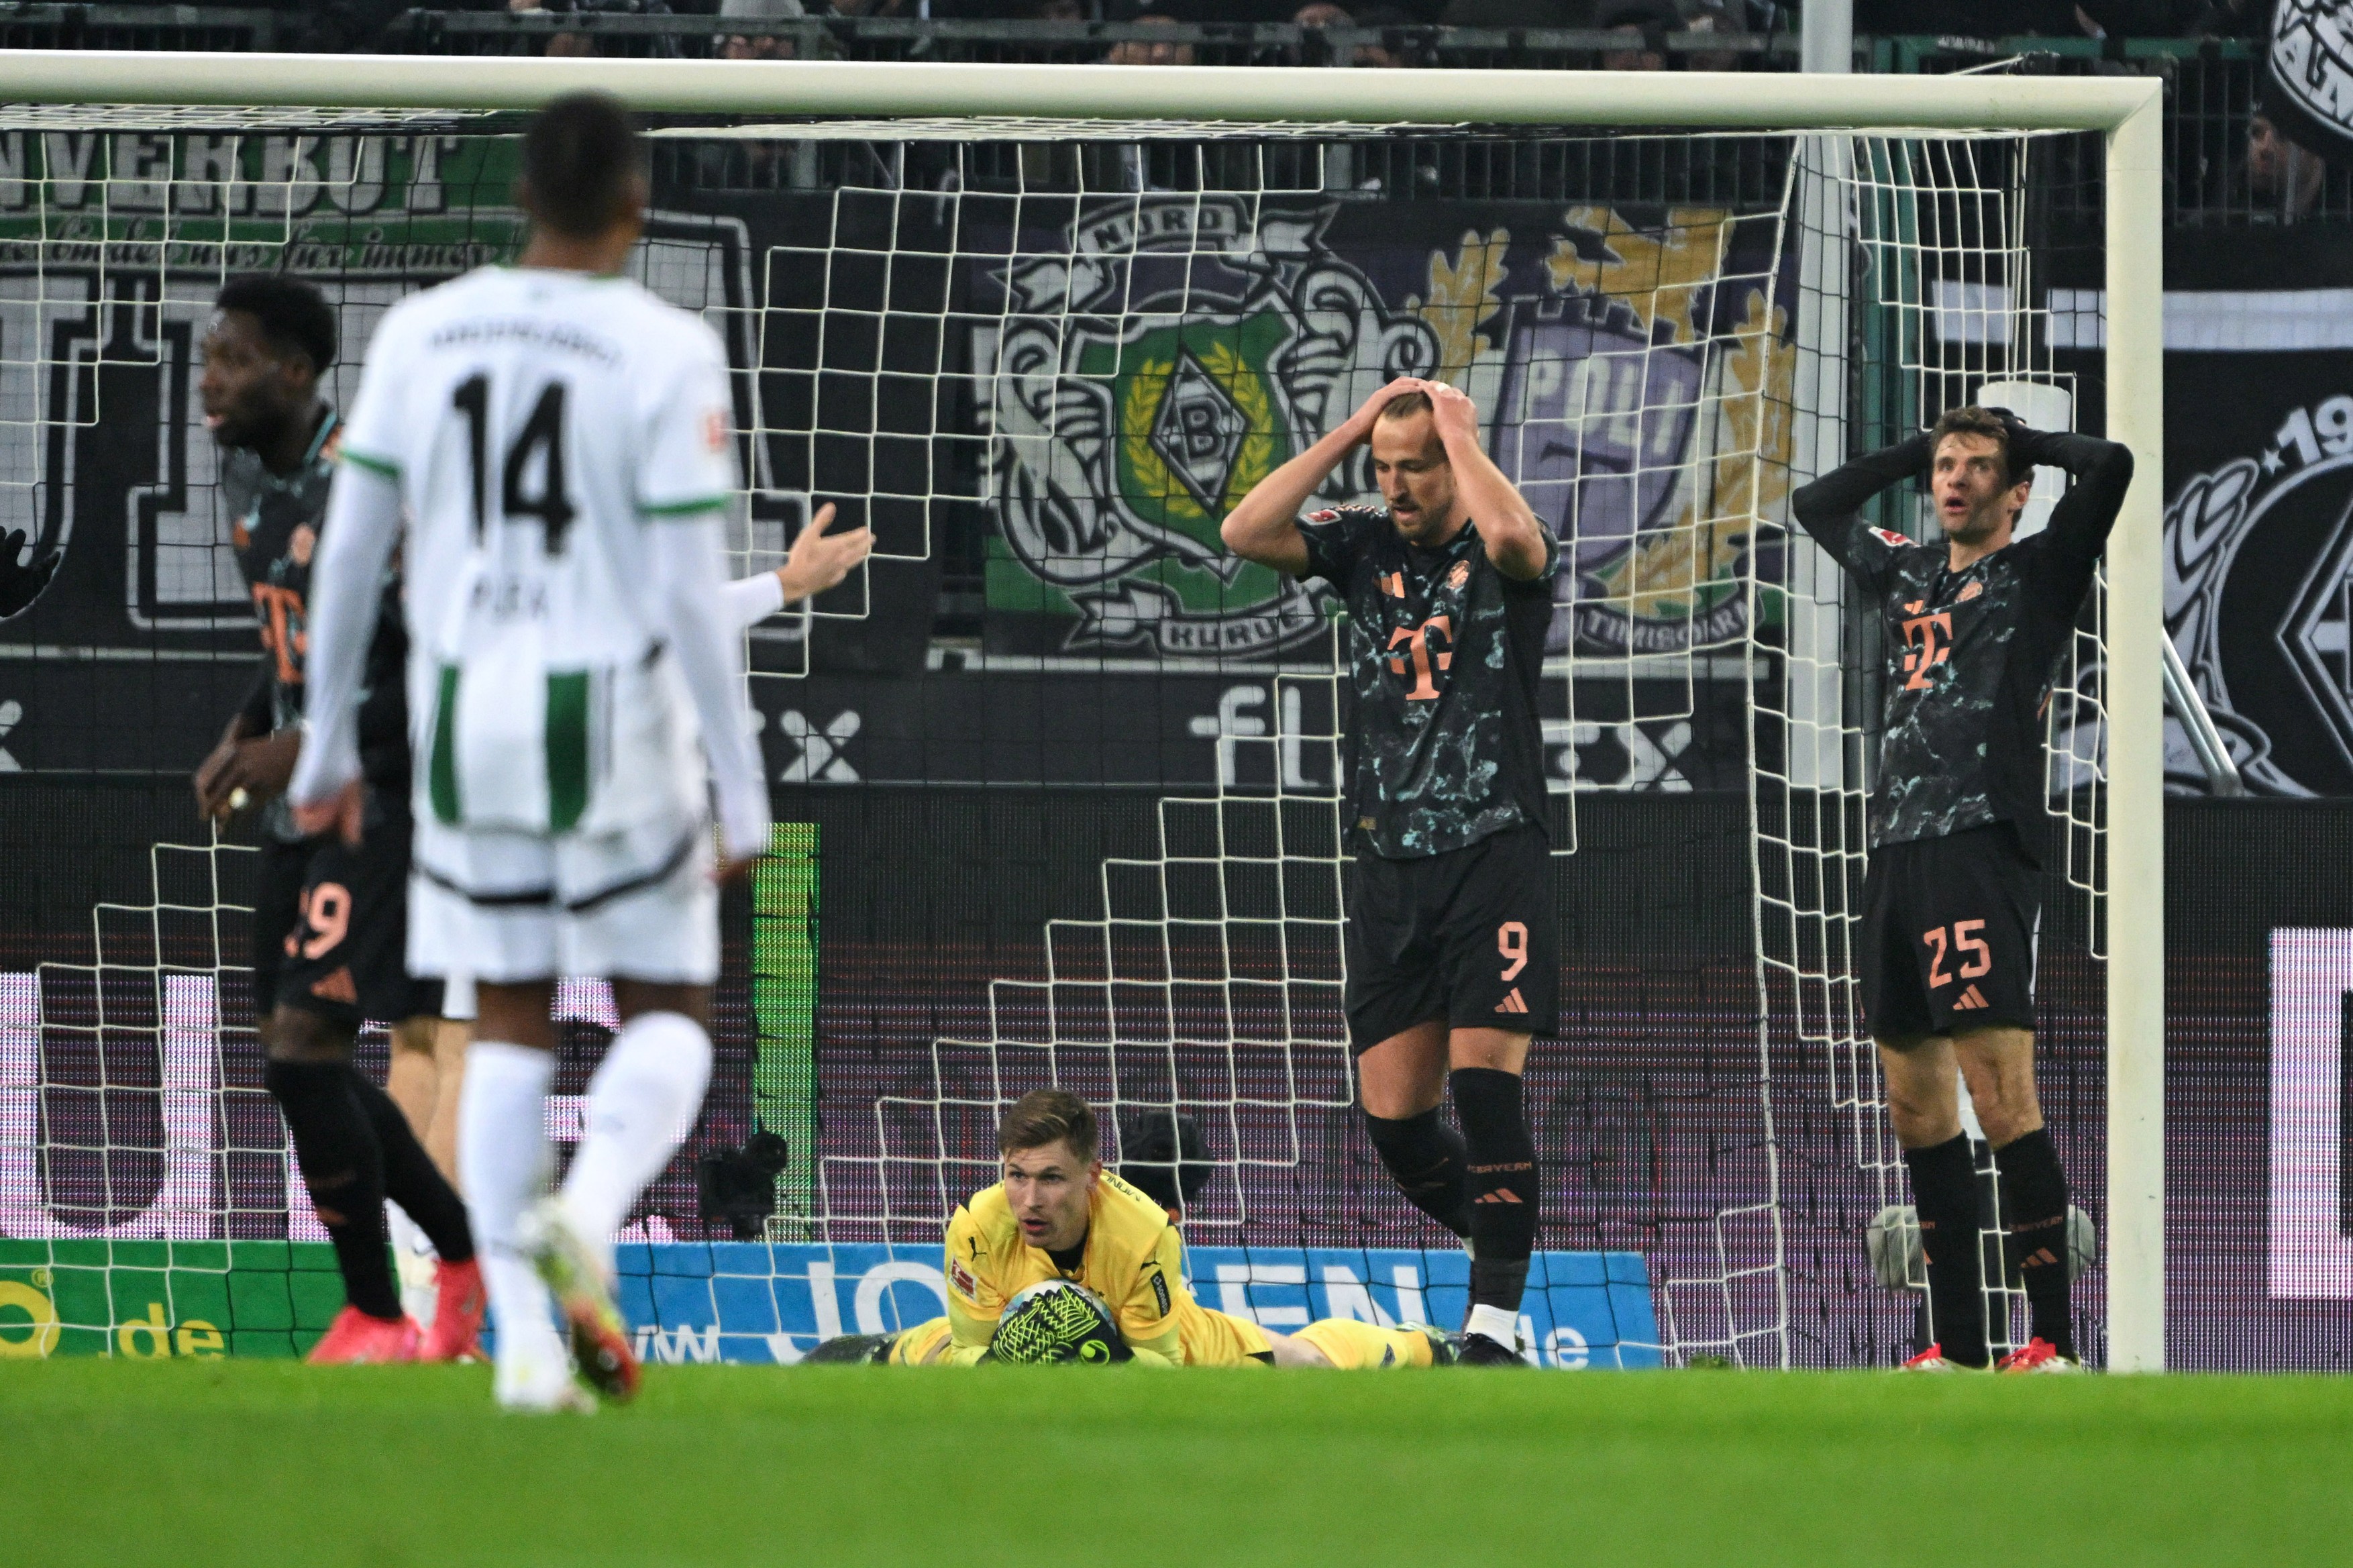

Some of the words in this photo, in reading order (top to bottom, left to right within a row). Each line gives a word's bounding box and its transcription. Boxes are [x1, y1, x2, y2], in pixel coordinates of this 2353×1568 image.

[1092, 207, 1222, 251] NORD
[1515, 348, 1681, 456] POLI
[451, 369, 577, 557] 14
[1498, 921, 1528, 982] 9
[1923, 919, 1992, 989] 25
